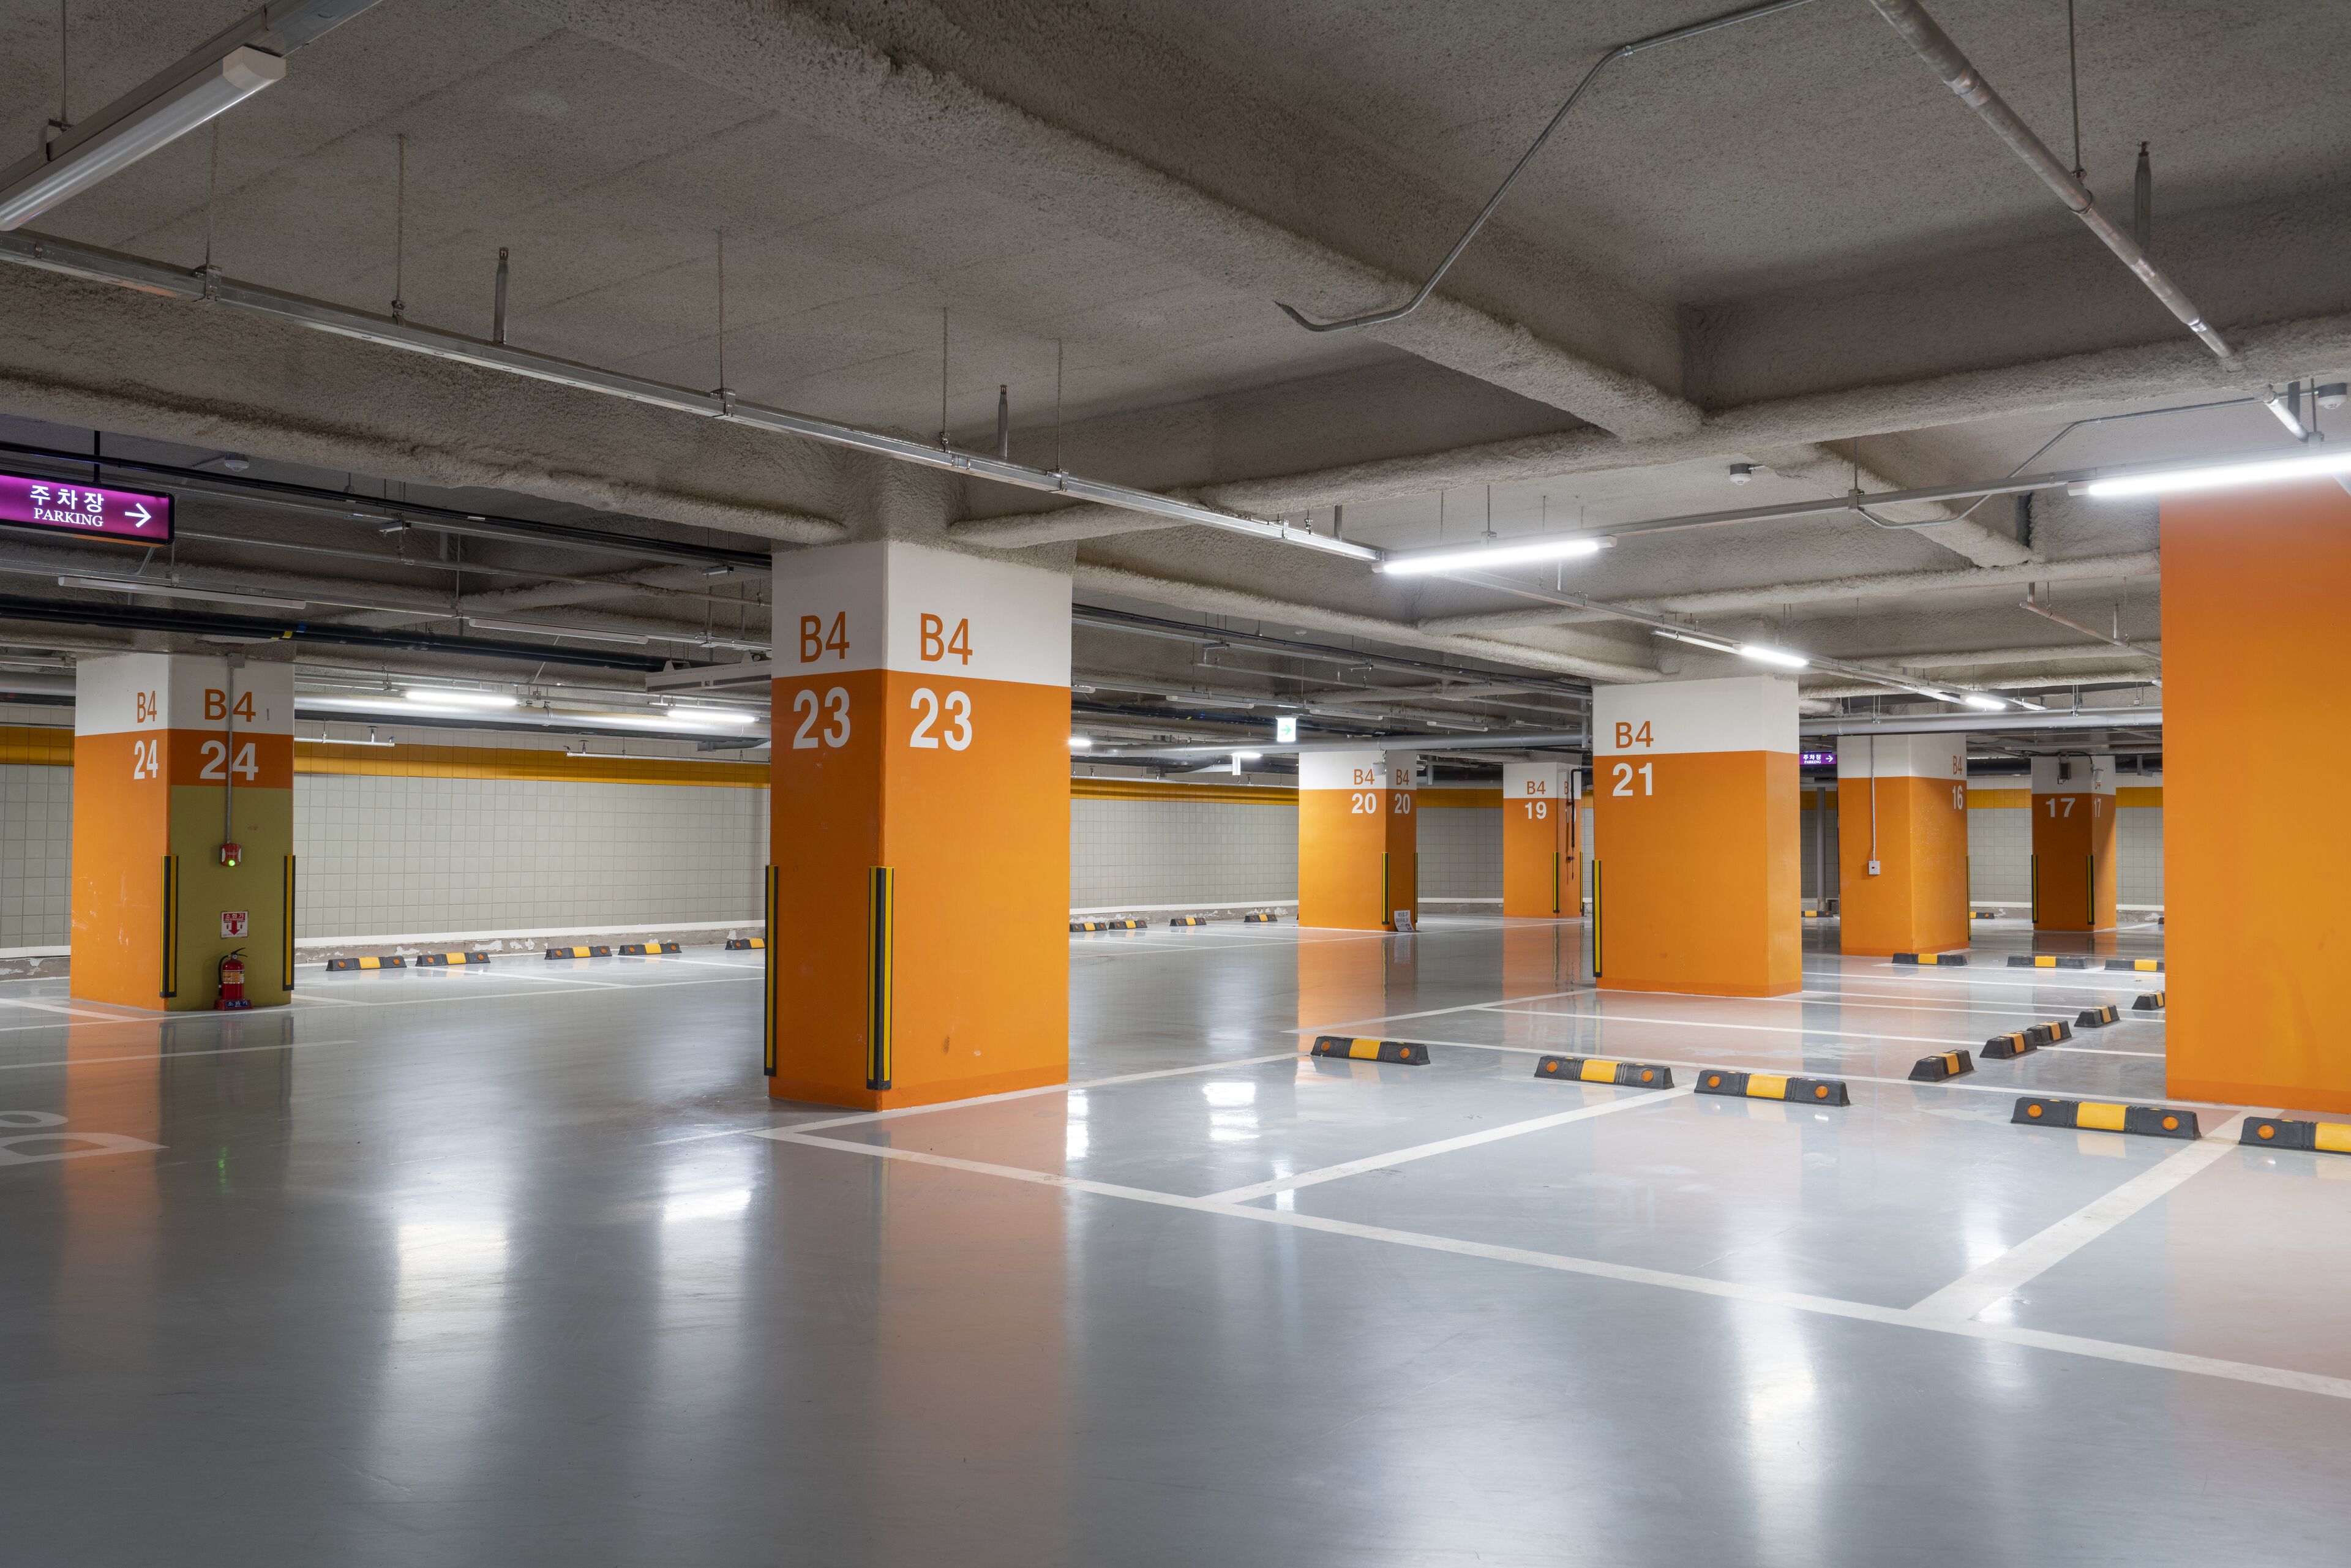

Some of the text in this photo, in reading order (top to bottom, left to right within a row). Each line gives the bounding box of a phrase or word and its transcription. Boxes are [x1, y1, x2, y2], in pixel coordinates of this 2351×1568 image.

[30, 484, 104, 513] 주차장
[34, 507, 104, 527] PARKING
[800, 611, 850, 663] B4
[920, 613, 973, 666] B4
[137, 691, 157, 723] B4
[204, 689, 256, 722] B4
[793, 686, 850, 749] 23
[910, 688, 972, 751] 23
[1616, 721, 1654, 749] B4
[133, 740, 159, 779] 24
[200, 740, 259, 781] 24
[1952, 755, 1963, 776] B4
[1354, 769, 1375, 785] B4
[1396, 769, 1410, 786] B4
[1526, 781, 1547, 795] B4
[1612, 763, 1653, 797] 21
[1351, 793, 1377, 814] 20
[1395, 793, 1411, 814] 20
[1524, 801, 1547, 820] 19
[1952, 785, 1963, 810] 16
[2045, 798, 2076, 818] 17
[2094, 798, 2101, 818] 17
